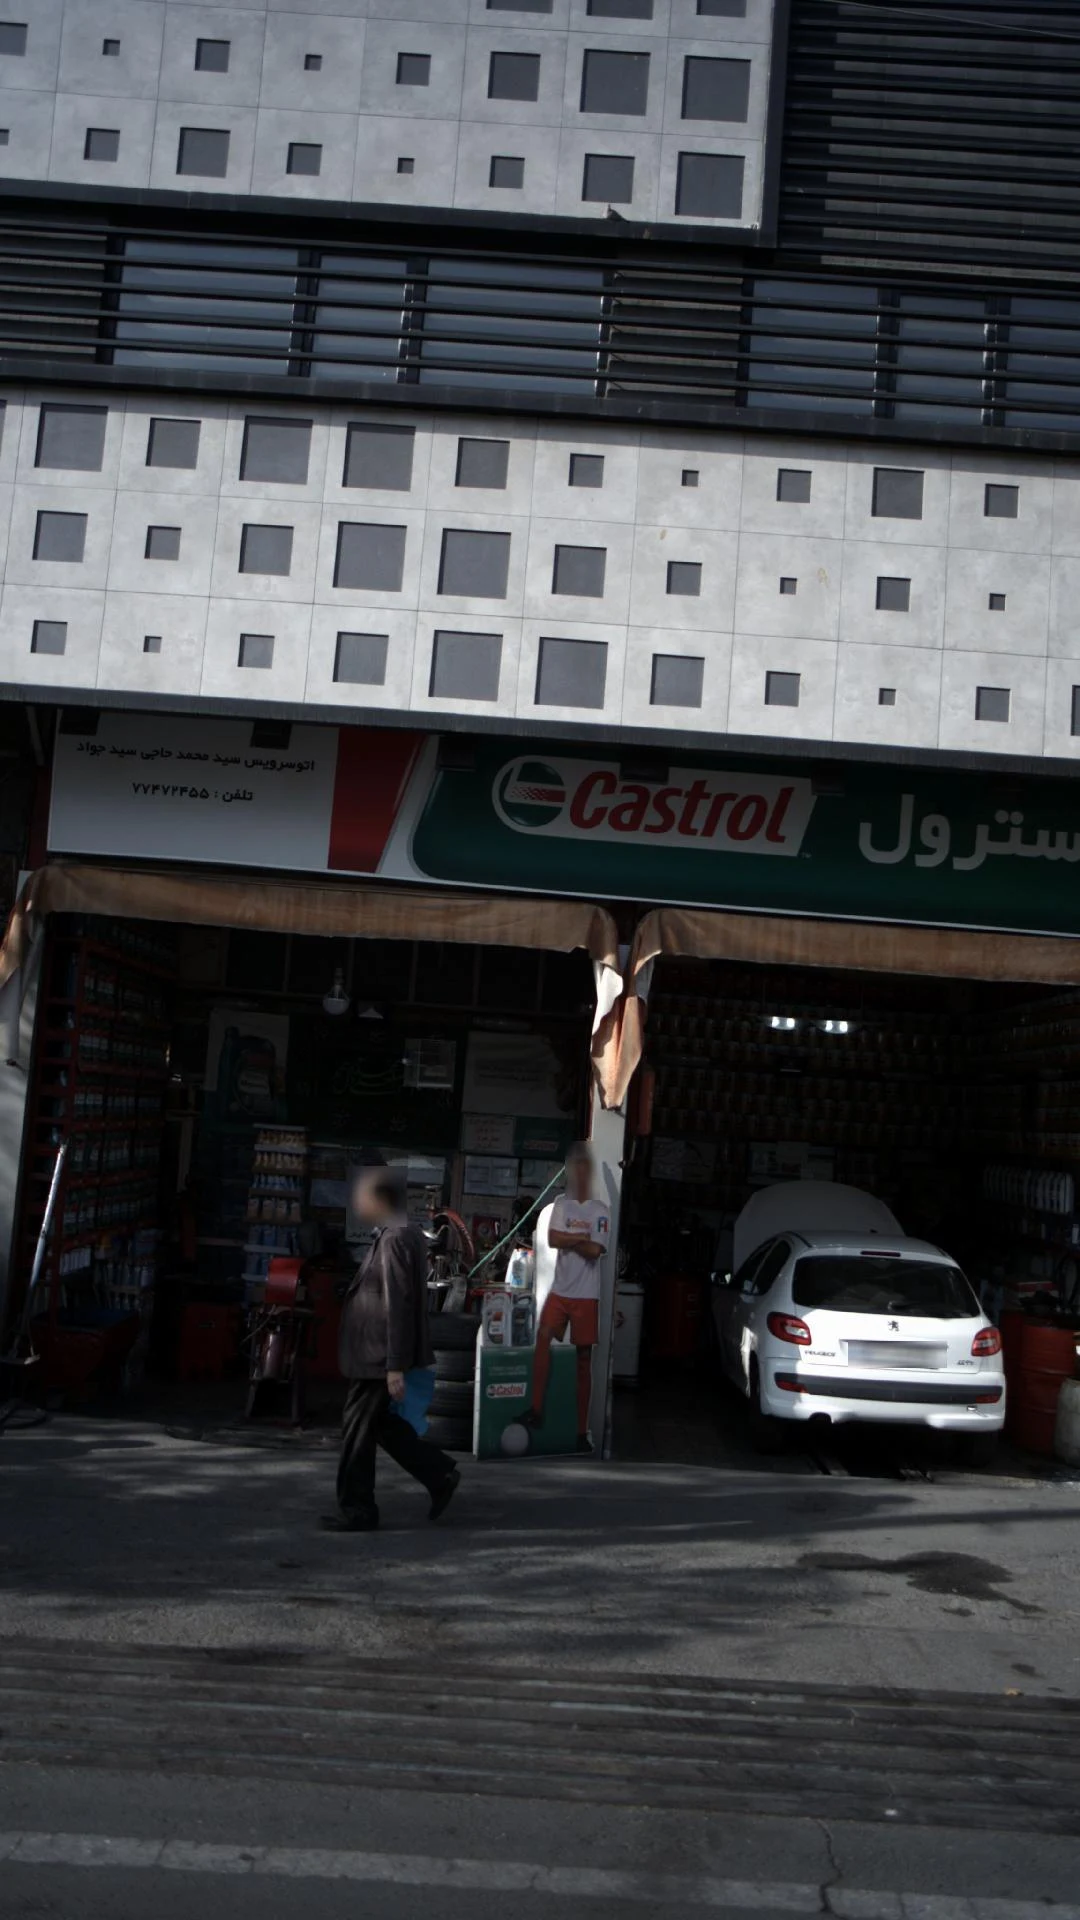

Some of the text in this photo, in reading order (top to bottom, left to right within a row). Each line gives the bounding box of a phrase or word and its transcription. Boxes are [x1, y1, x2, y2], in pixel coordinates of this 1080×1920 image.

[76, 741, 316, 773] اتوسرویس سید محمد حاجی سید جواد
[569, 770, 796, 843] Castrol
